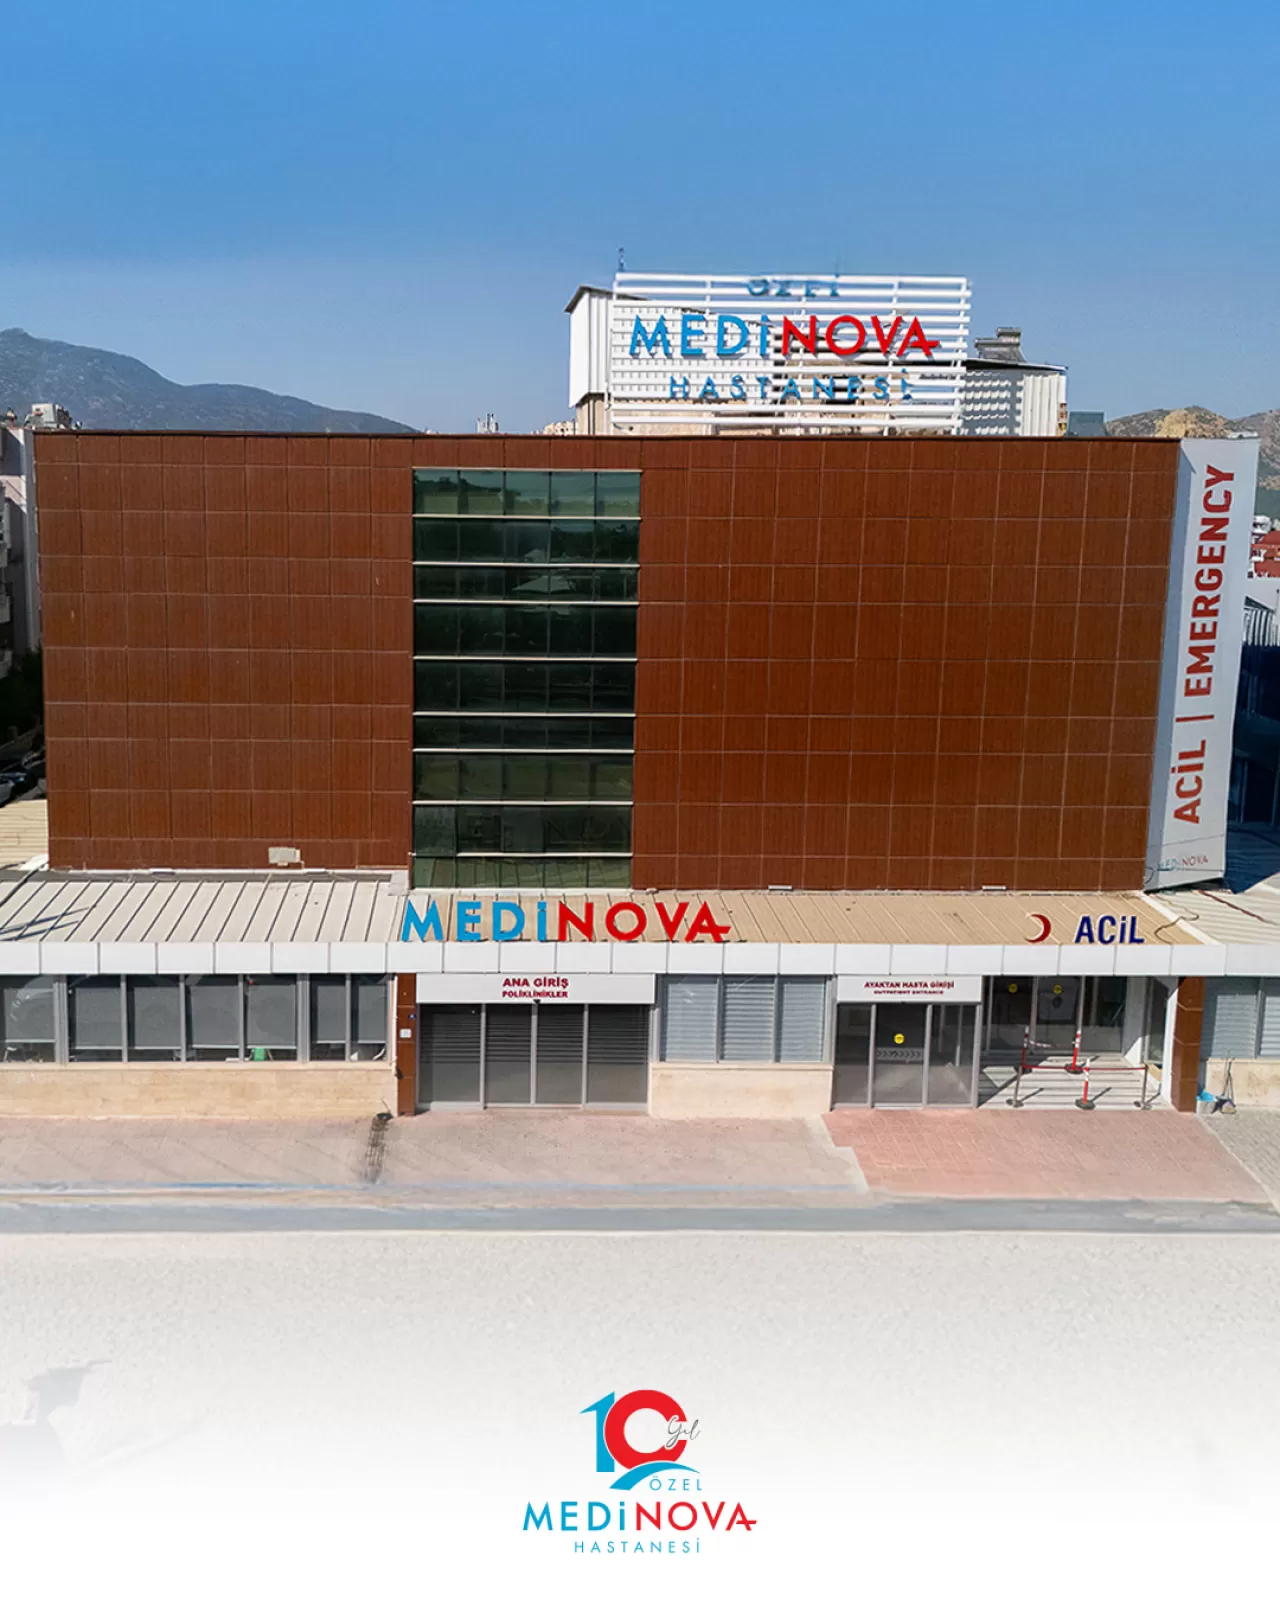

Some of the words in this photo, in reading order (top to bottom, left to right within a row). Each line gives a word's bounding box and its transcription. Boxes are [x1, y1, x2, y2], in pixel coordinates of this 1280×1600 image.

[1184, 464, 1235, 697] EMERGENCY
[502, 978, 530, 987] ANA
[533, 976, 569, 989] GİRİŞ
[502, 990, 568, 998] POLİKLİNİKLER
